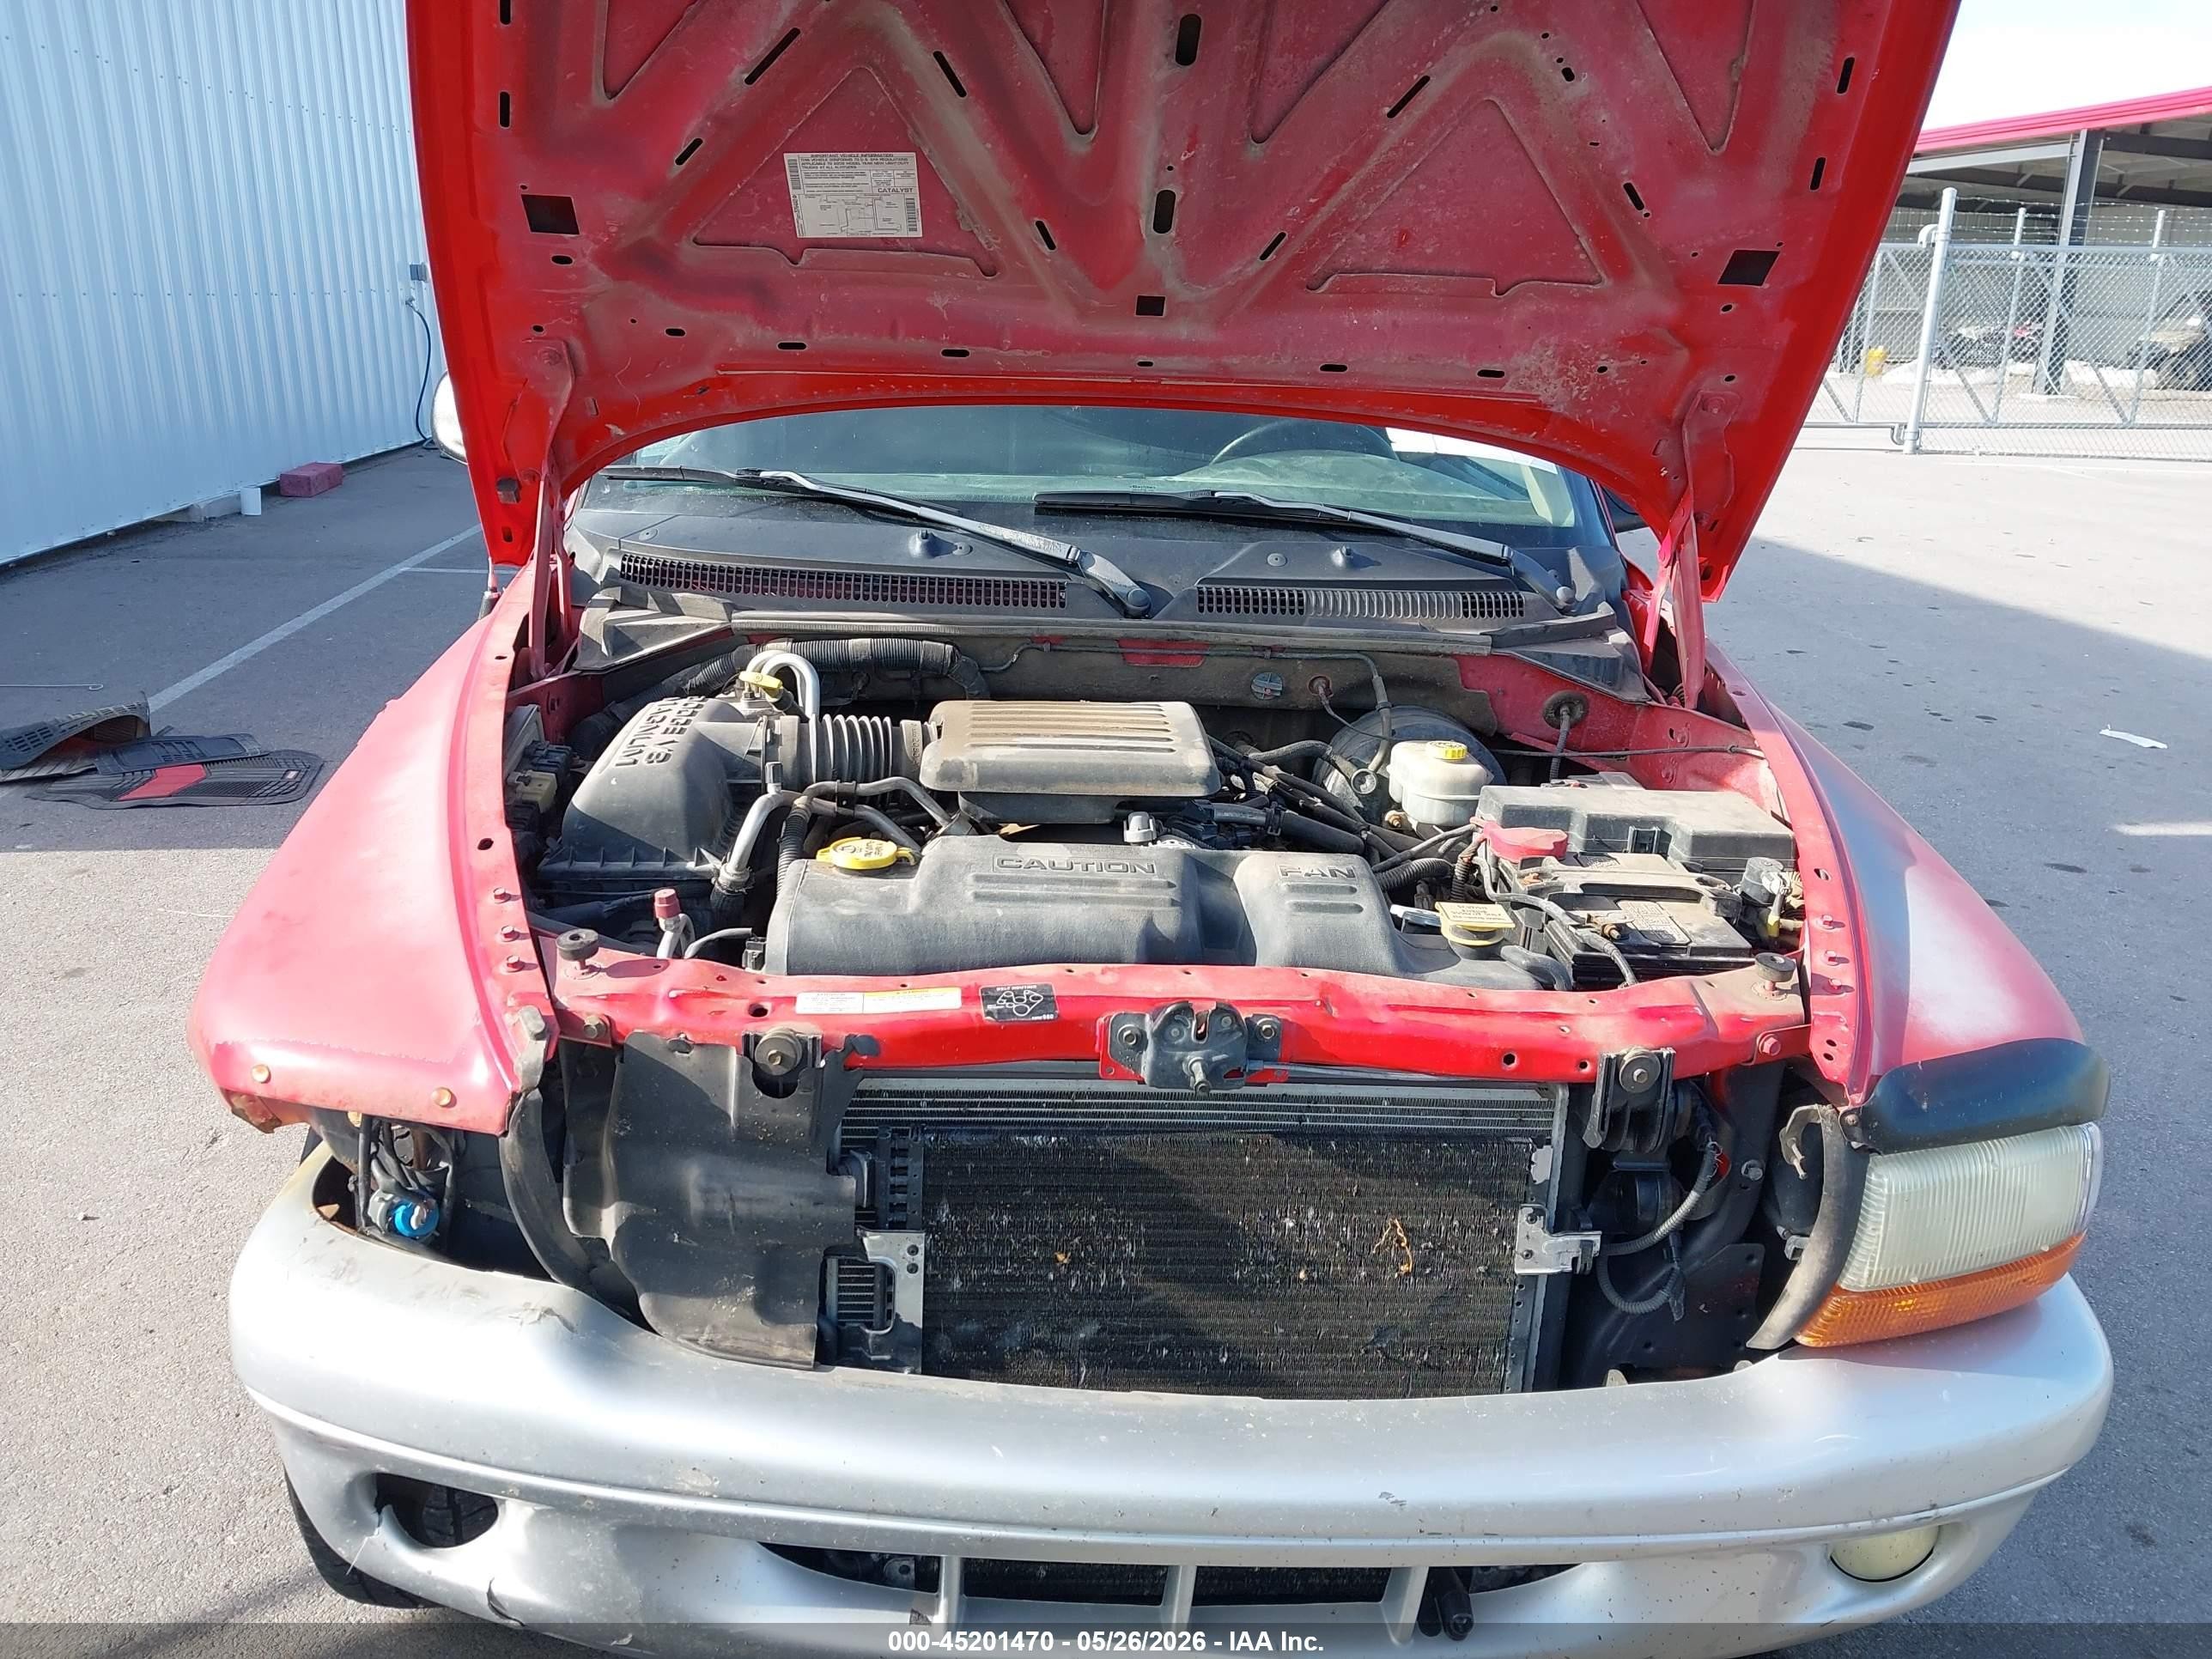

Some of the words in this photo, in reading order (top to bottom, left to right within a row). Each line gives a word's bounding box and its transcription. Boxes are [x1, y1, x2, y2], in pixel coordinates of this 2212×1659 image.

[615, 696, 682, 767] MAGNUM
[644, 738, 679, 765] V8
[996, 857, 1156, 874] CAUTION
[1279, 865, 1356, 878] FAN
